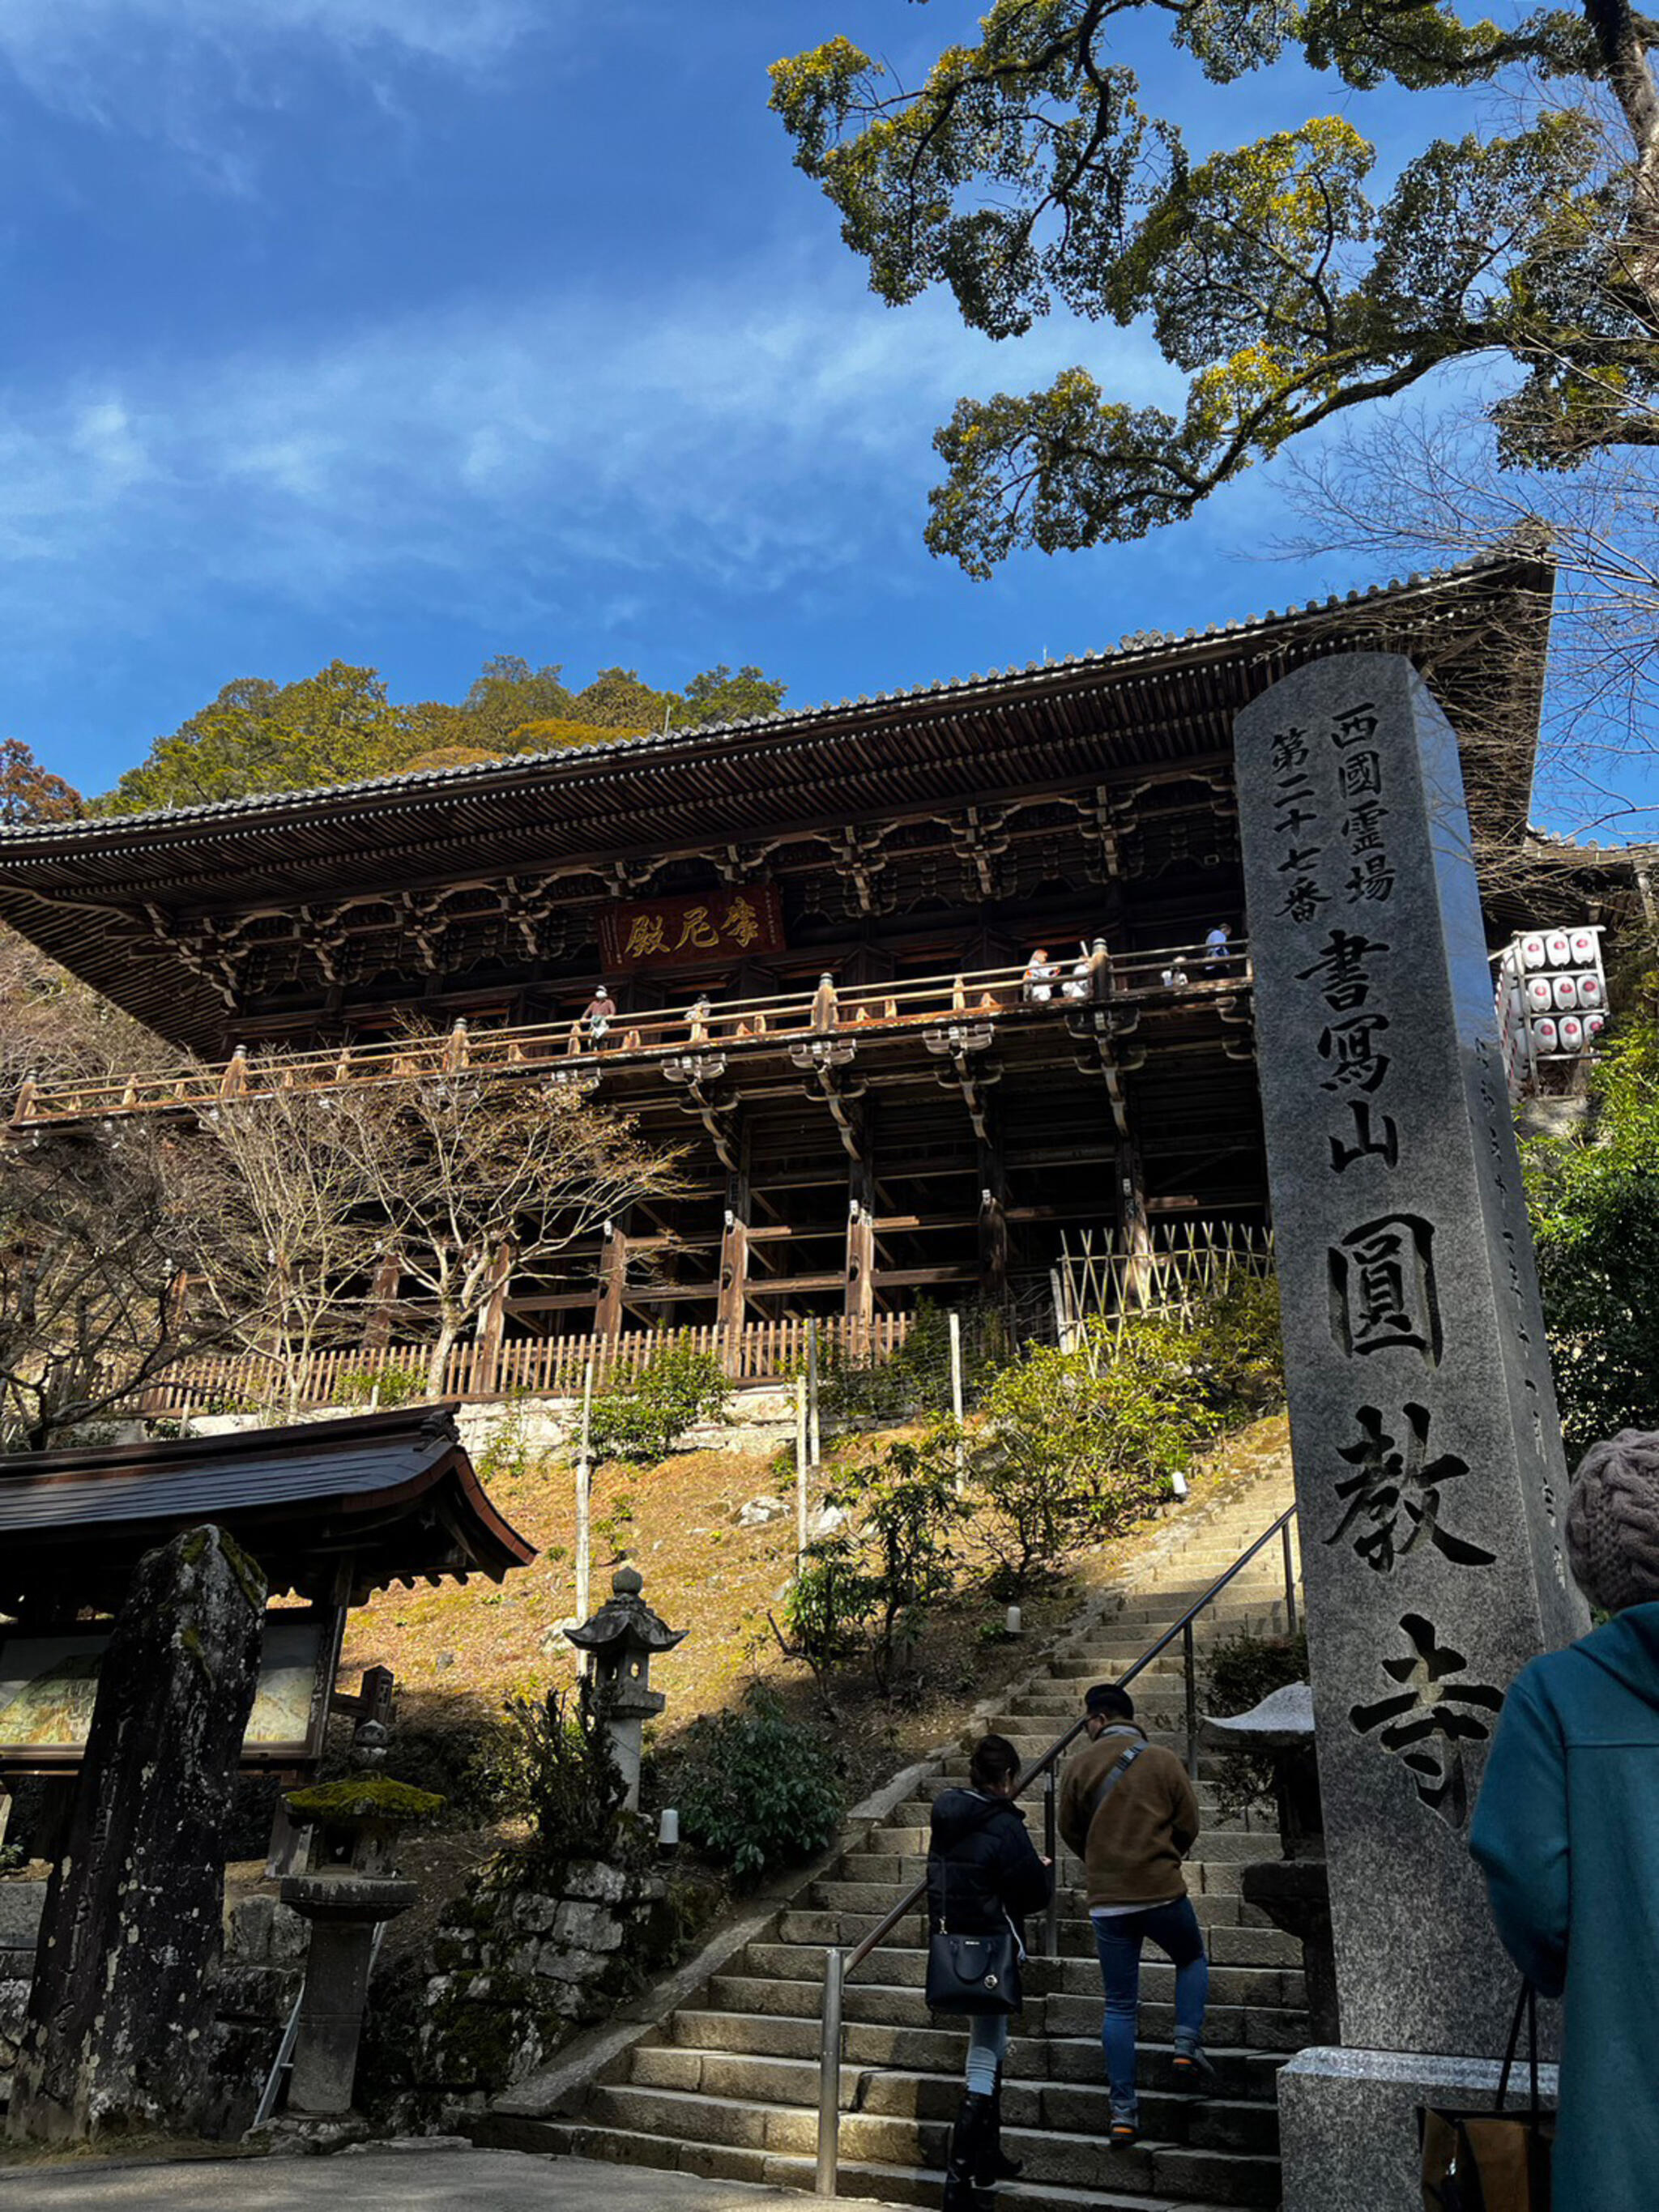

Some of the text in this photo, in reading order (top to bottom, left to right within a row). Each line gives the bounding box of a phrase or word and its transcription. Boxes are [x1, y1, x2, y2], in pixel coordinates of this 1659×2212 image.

[1269, 727, 1332, 923] 第二十七番
[624, 896, 759, 957] 摩尼殿
